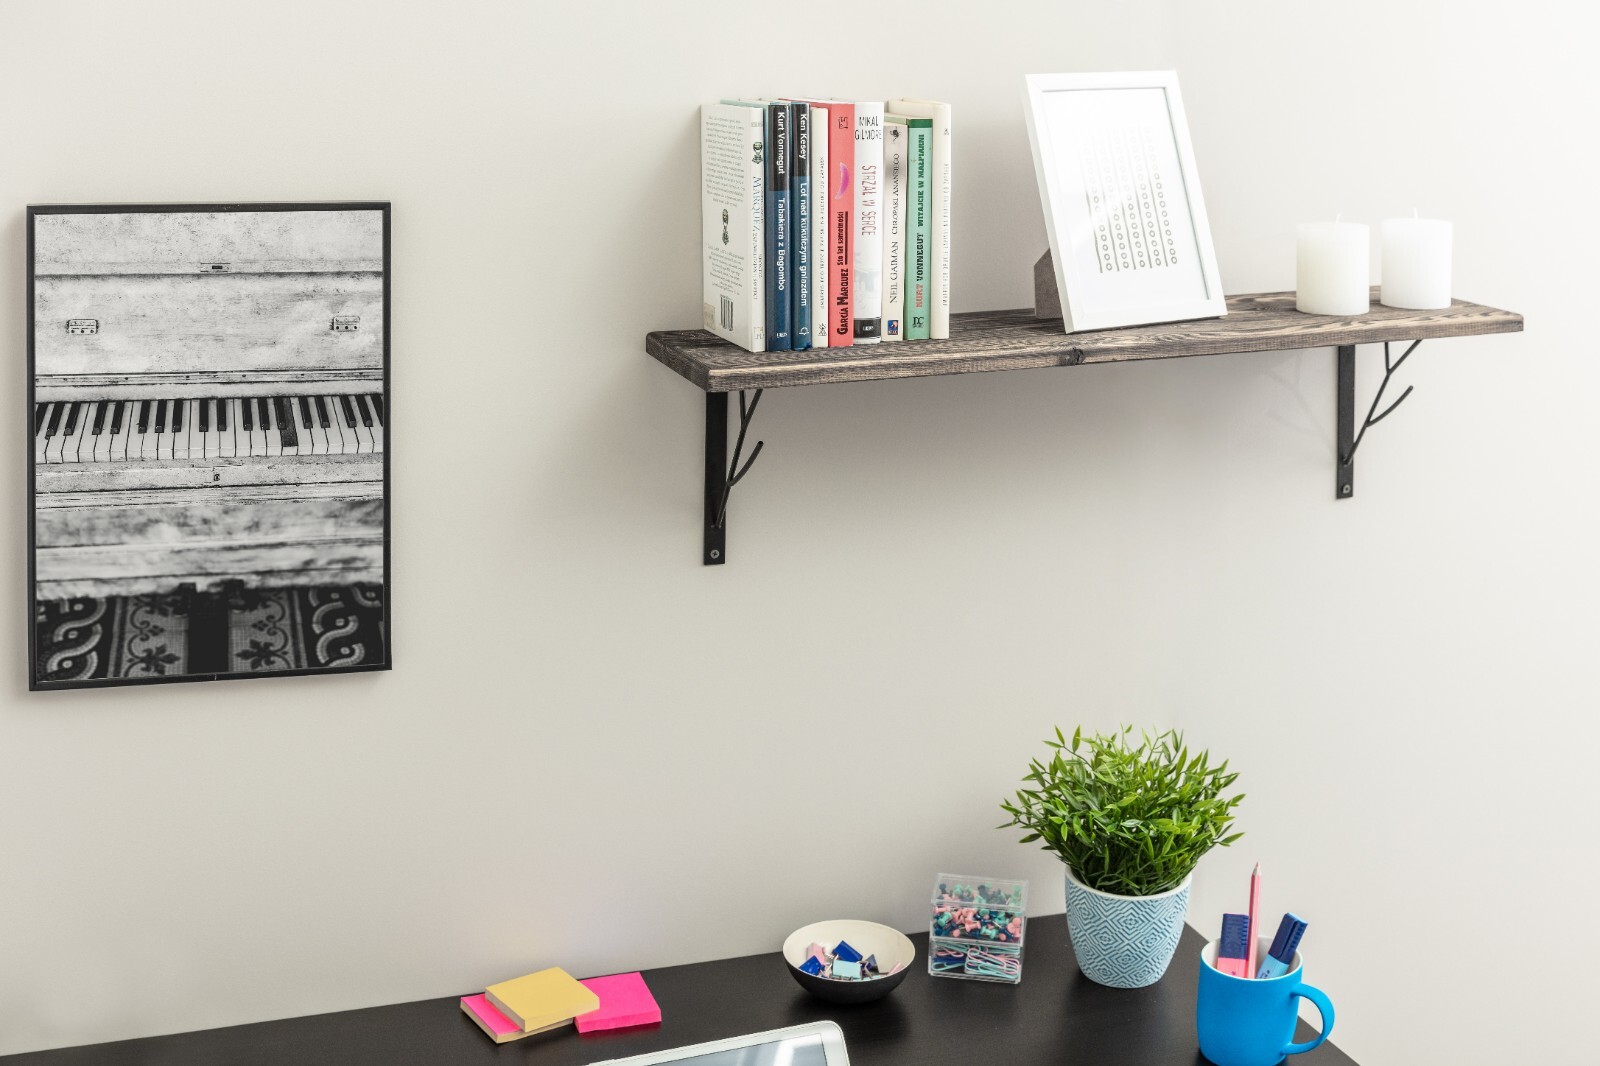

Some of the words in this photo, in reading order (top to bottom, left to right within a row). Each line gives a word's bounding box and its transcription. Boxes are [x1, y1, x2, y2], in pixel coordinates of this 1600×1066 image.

[777, 111, 786, 131] Kurt
[800, 113, 808, 131] Ken
[775, 133, 786, 175] Vonnegut
[798, 133, 808, 160] Kesey
[800, 182, 809, 197] Lot
[917, 180, 924, 189] W
[777, 197, 786, 240] Tabakiera
[800, 199, 809, 216] nad
[862, 211, 877, 236] SERCE
[836, 245, 844, 255] lat
[836, 255, 844, 266] Sto
[889, 241, 898, 281] GAIMAN
[916, 233, 924, 282] VONNEGUT
[776, 249, 786, 291] Bagombo
[798, 265, 809, 307] gniazdem
[889, 282, 898, 304] NEIL
